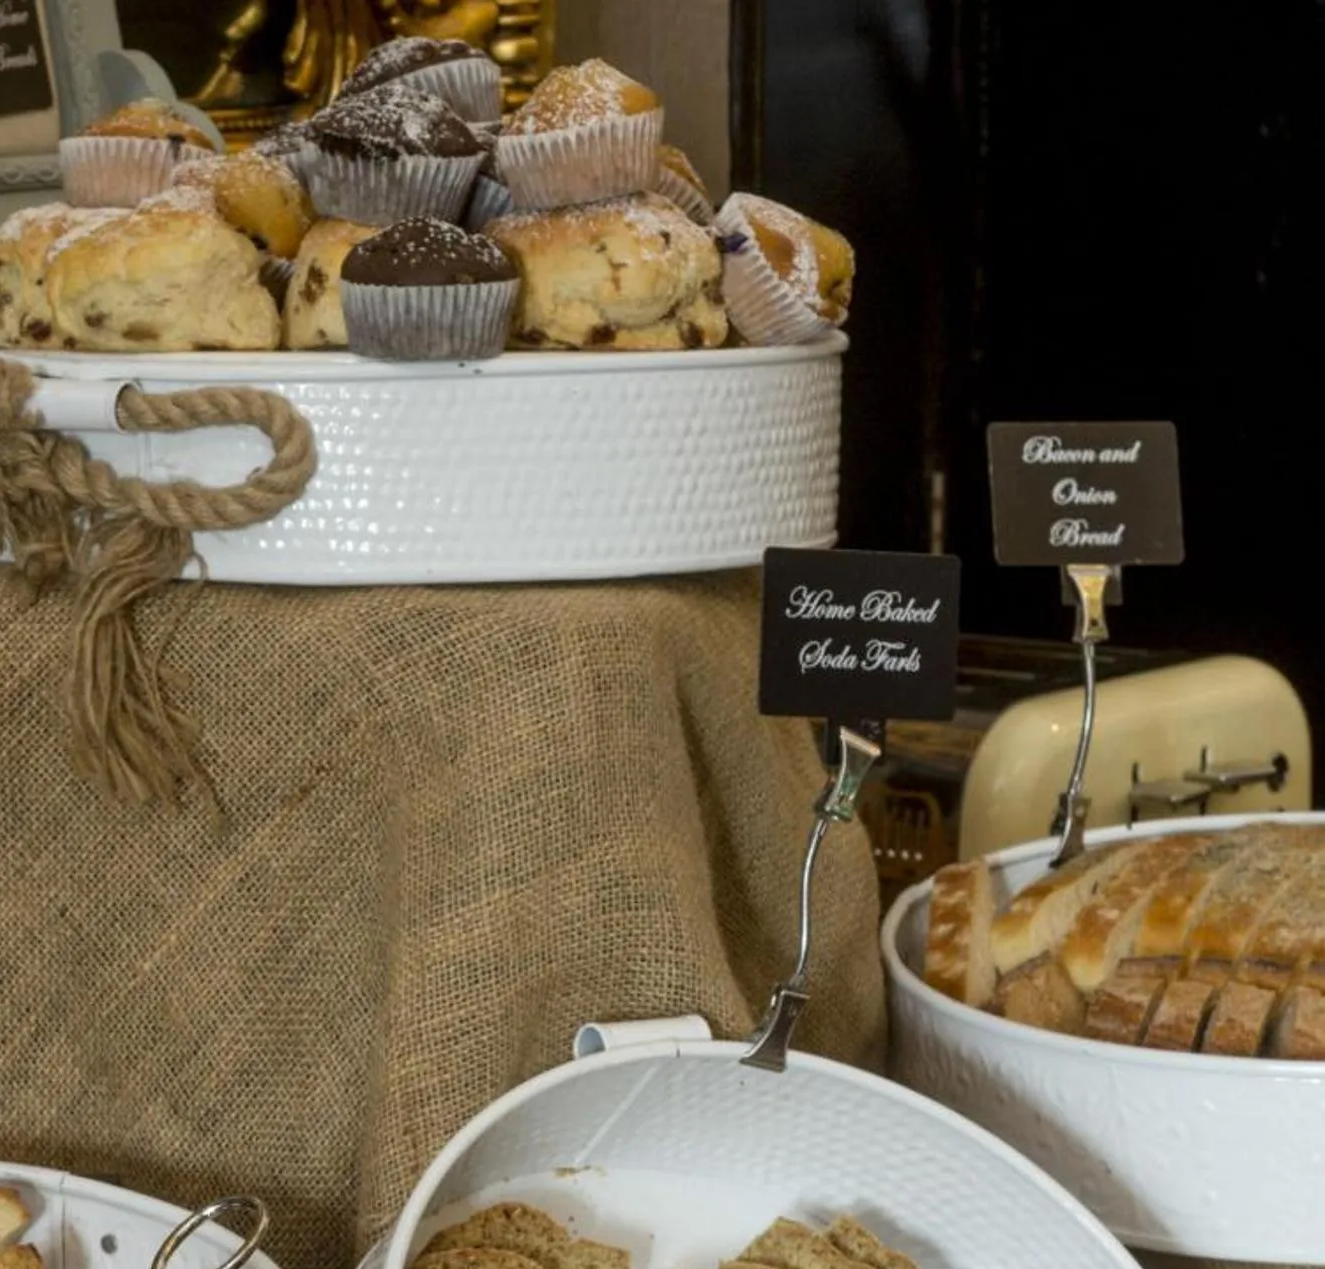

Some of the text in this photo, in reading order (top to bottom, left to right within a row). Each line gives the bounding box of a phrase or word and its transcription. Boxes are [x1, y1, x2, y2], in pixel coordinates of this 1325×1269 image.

[1021, 435, 1142, 464] Bacon and
[1051, 478, 1117, 506] Onion
[1049, 518, 1125, 547] Bread
[785, 585, 941, 623] Home Baked
[798, 638, 922, 674] Soda Farls
